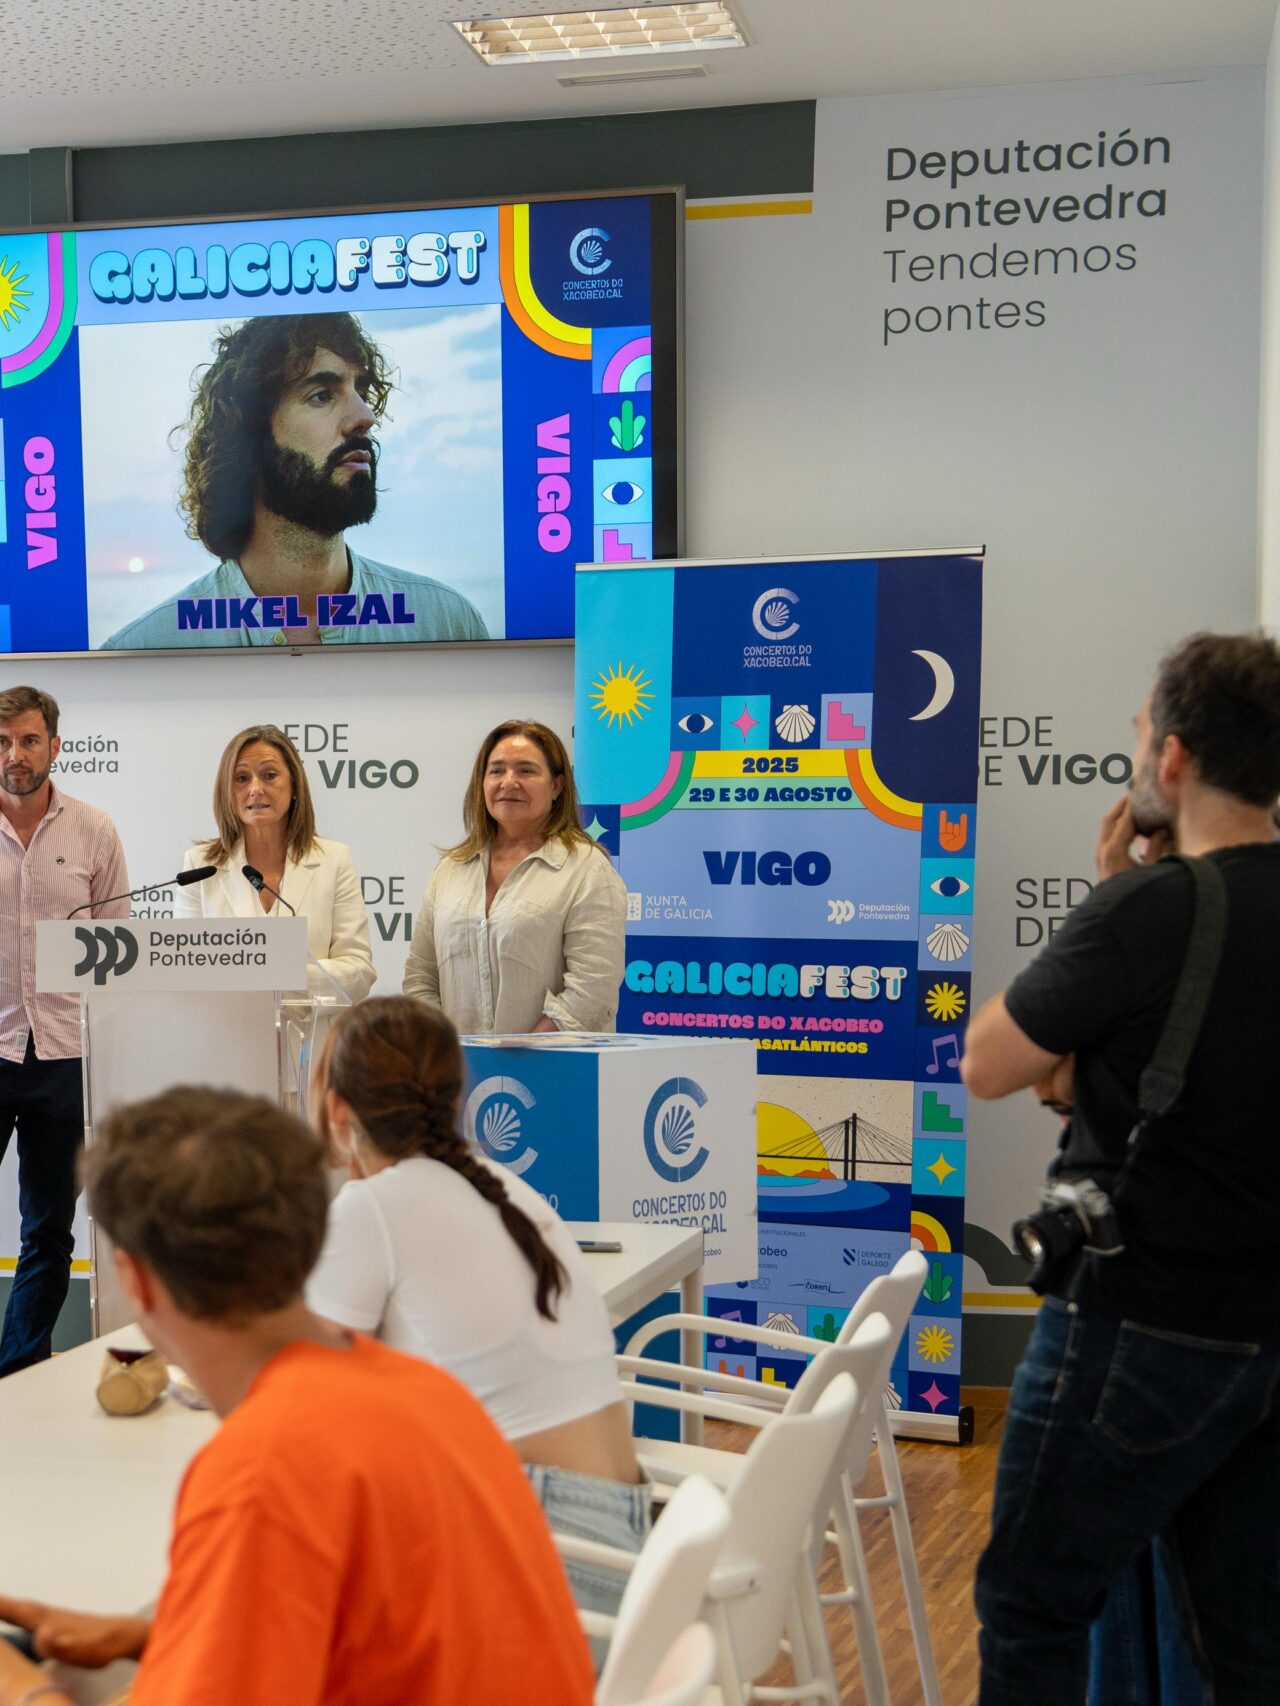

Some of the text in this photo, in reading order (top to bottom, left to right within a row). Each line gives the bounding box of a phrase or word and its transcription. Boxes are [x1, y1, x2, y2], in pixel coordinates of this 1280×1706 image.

[886, 128, 1171, 189] Deputación
[885, 184, 1167, 233] Pontevedra
[89, 230, 487, 304] GALICIAFEST
[883, 242, 1138, 284] Tendemos
[562, 278, 624, 291] CONCERTOS DO
[882, 297, 1047, 346] pontes
[536, 412, 572, 553] VIGO
[23, 436, 58, 570] VIGO
[177, 592, 416, 630] MIKEL IZAL
[743, 644, 812, 656] CONCERTOS DO
[61, 735, 119, 753] ación
[284, 723, 349, 753] EDE
[979, 716, 1053, 748] EDE
[49, 757, 119, 773] evedra
[317, 759, 419, 789] VIGO
[742, 757, 800, 773] 2025
[978, 753, 1134, 786] E VIGO
[689, 787, 853, 802] 29 E 30 AGOSTO
[703, 851, 832, 887] VIGO
[360, 876, 405, 905] DE
[645, 896, 687, 907] XUNTA
[1015, 878, 1095, 909] SED
[645, 908, 713, 920] DE GALICIA
[858, 912, 910, 921] Pontevedra
[859, 903, 910, 913] Deputación
[150, 928, 267, 951] Deputación
[373, 912, 413, 942] VI
[150, 950, 267, 967] Pontevedra
[624, 960, 908, 1001] GALICIAFEST
[642, 1012, 884, 1033] CONCERTOS DO XACOBEO
[632, 1190, 727, 1218] CONCERTOS DO
[861, 1251, 892, 1260] DEPORTE
[861, 1259, 889, 1268] GALEGO
